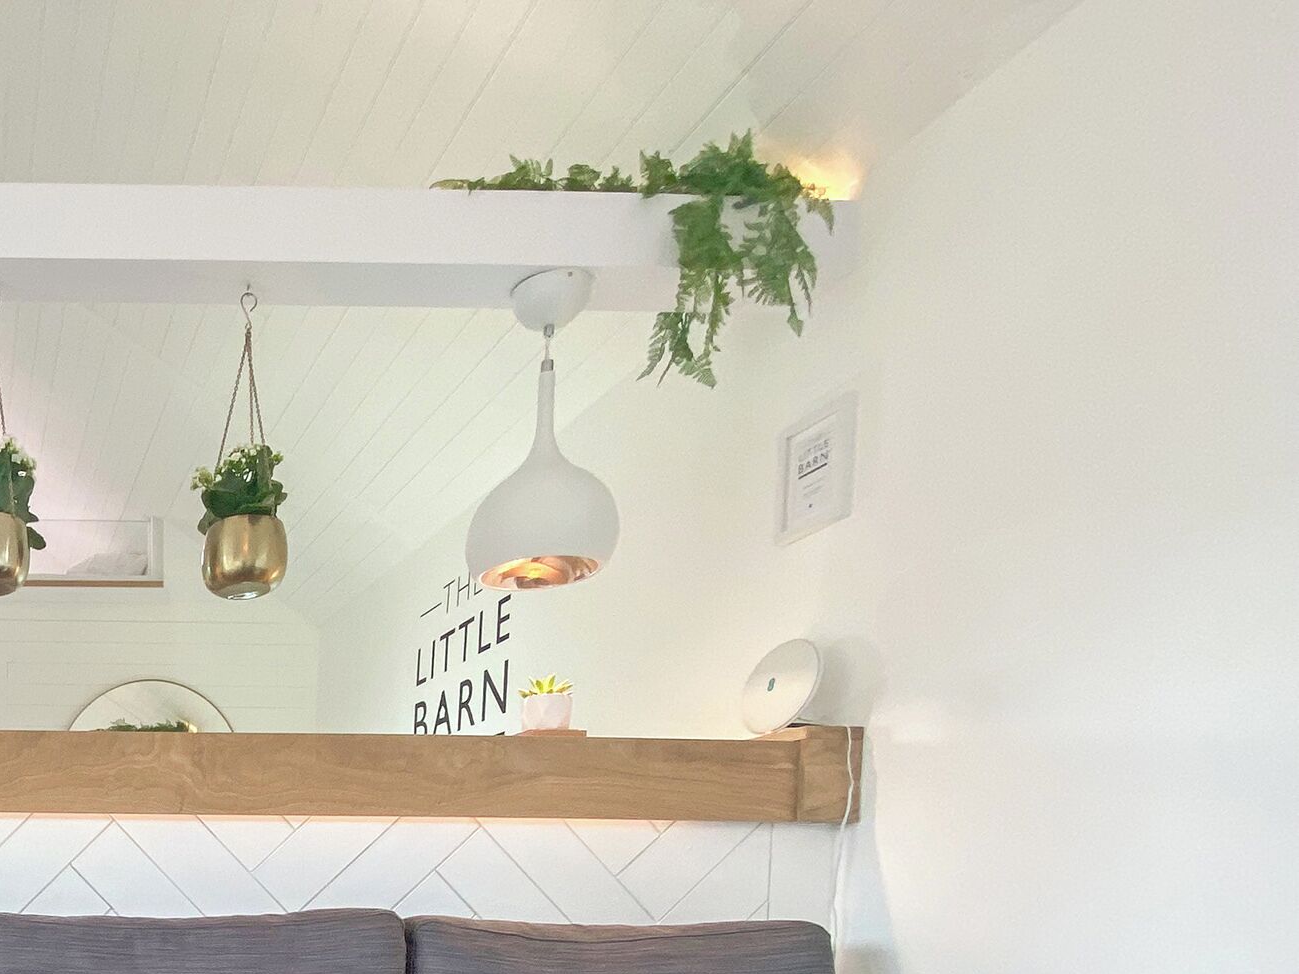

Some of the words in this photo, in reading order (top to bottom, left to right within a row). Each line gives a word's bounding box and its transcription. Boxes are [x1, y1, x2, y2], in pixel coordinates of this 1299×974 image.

[798, 450, 831, 475] BARN
[416, 593, 512, 687] LITTLE
[413, 658, 509, 735] BARN
